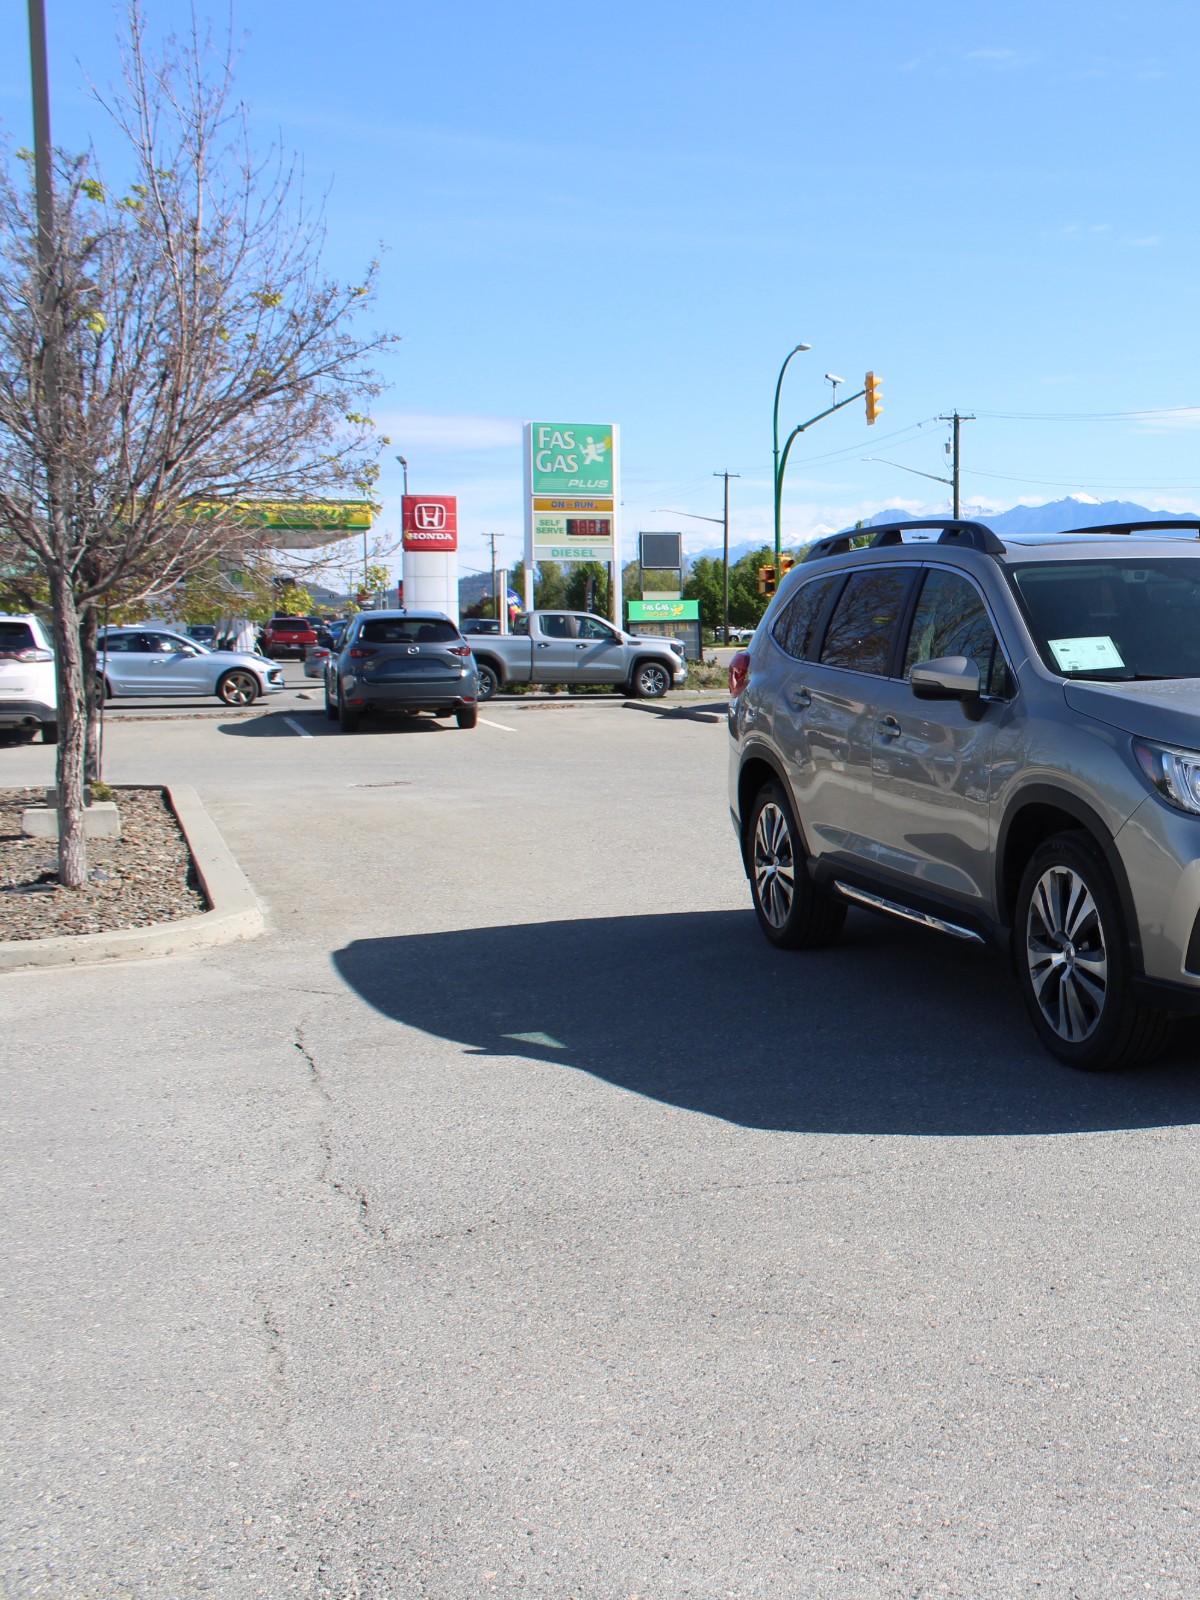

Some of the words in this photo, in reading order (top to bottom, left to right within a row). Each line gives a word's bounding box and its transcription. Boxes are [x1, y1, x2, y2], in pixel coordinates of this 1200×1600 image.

[538, 426, 576, 450] FAS
[535, 449, 579, 473] GAS
[567, 479, 609, 488] PLUS
[408, 532, 454, 540] HONDA
[551, 548, 597, 558] DIESEL
[642, 603, 654, 611] FAS
[655, 602, 669, 611] GAS
